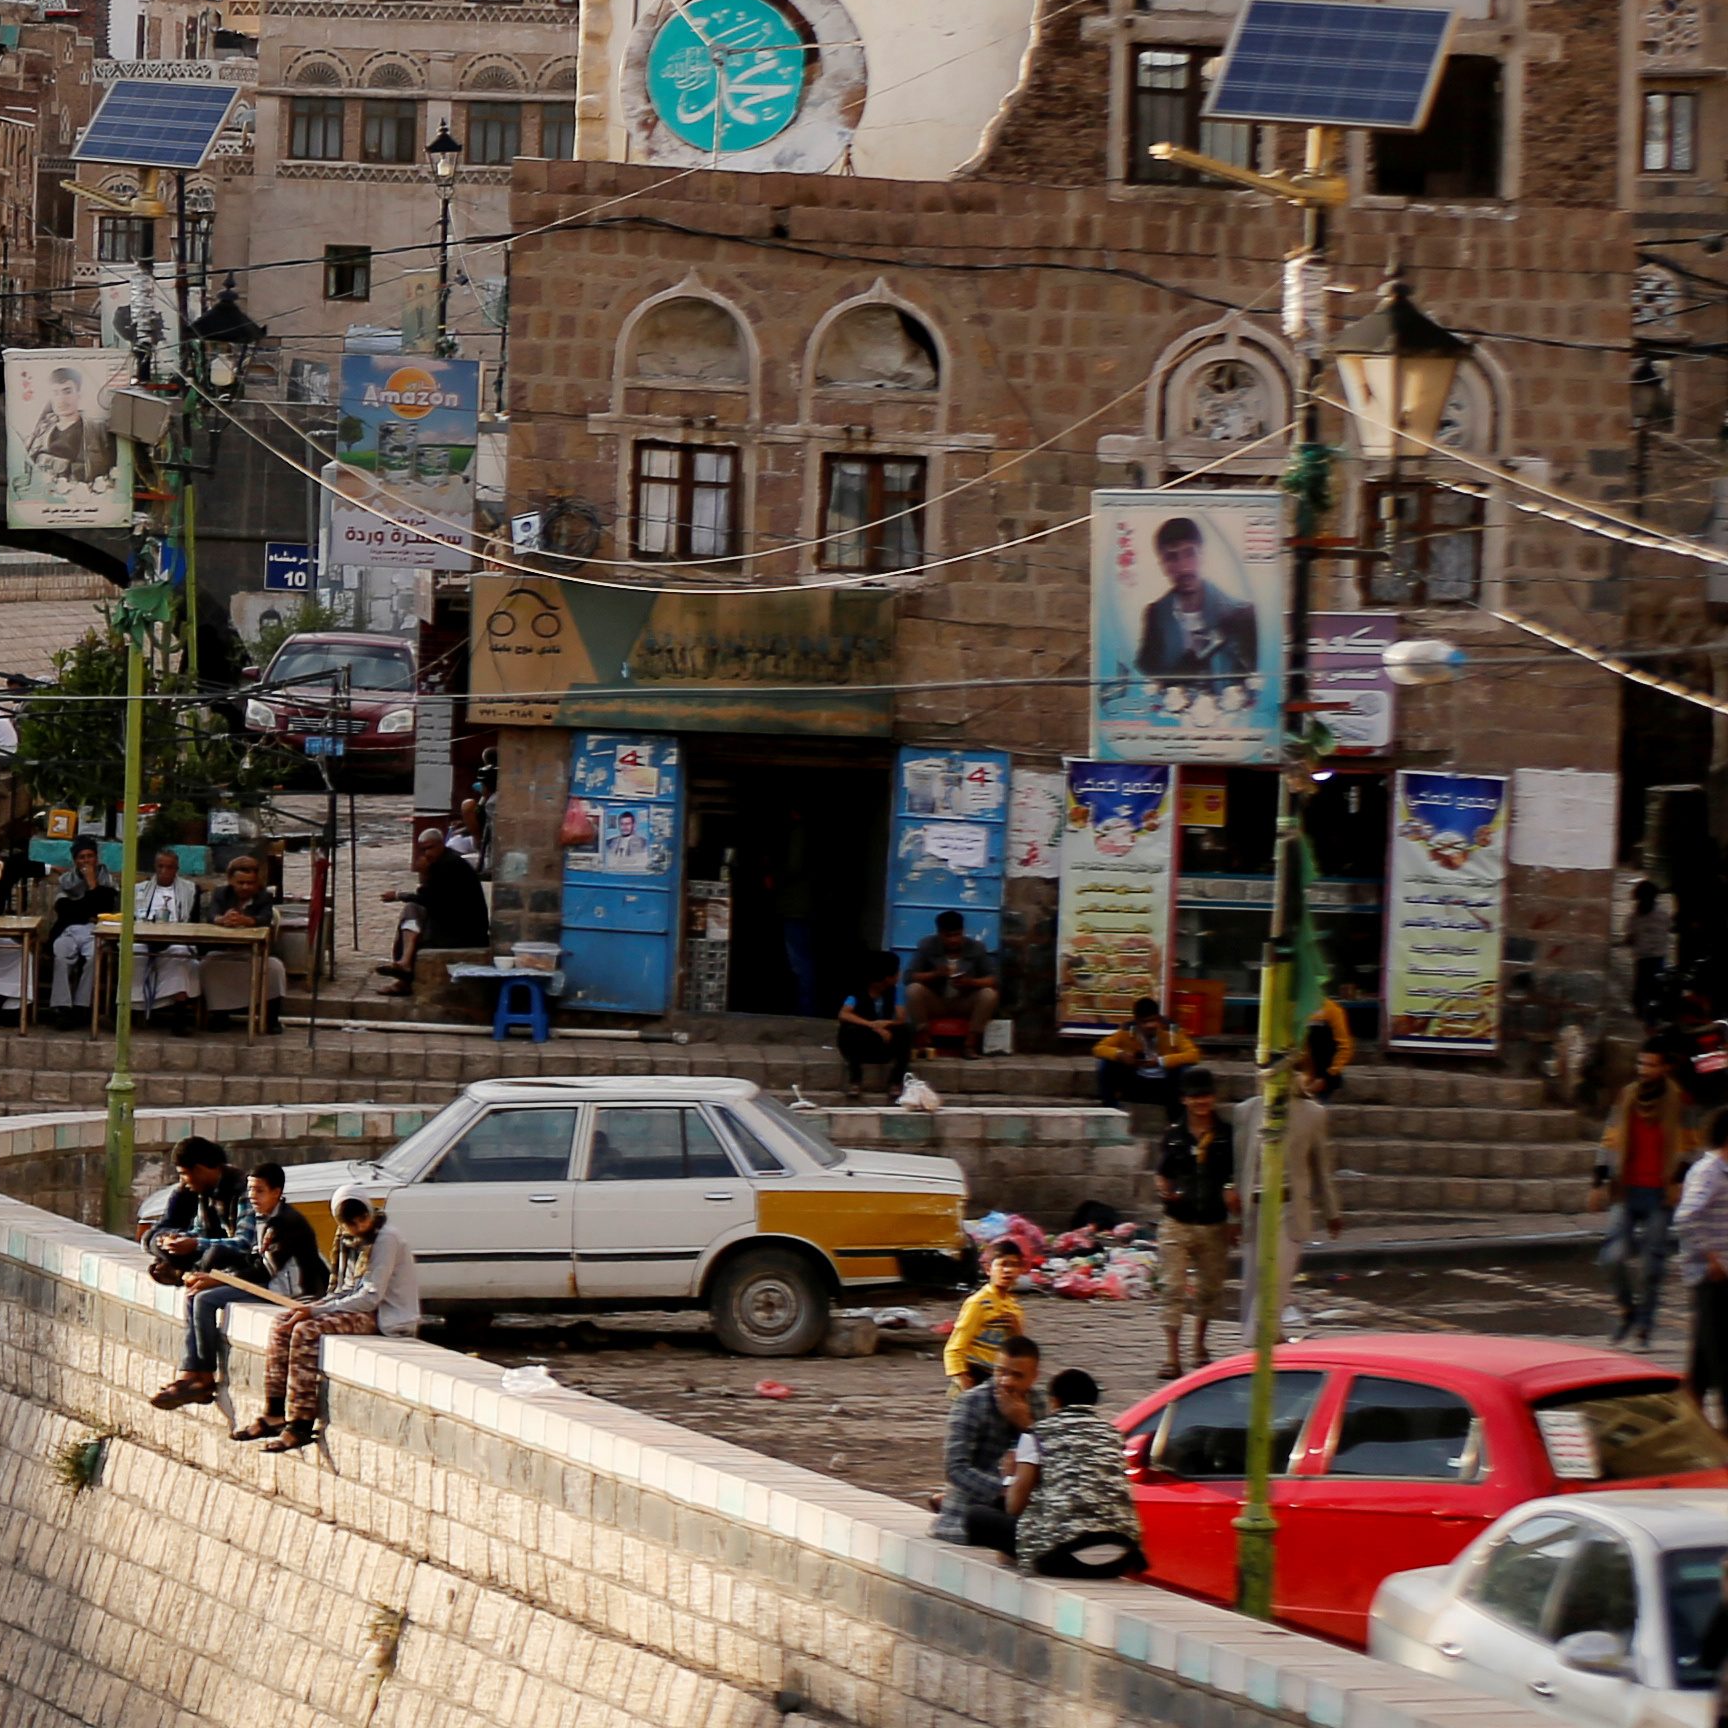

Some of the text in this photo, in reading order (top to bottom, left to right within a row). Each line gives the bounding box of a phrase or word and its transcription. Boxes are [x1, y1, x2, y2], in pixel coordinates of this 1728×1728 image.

[362, 383, 459, 408] Amazon
[345, 526, 385, 545] وردة
[284, 571, 306, 587] 10
